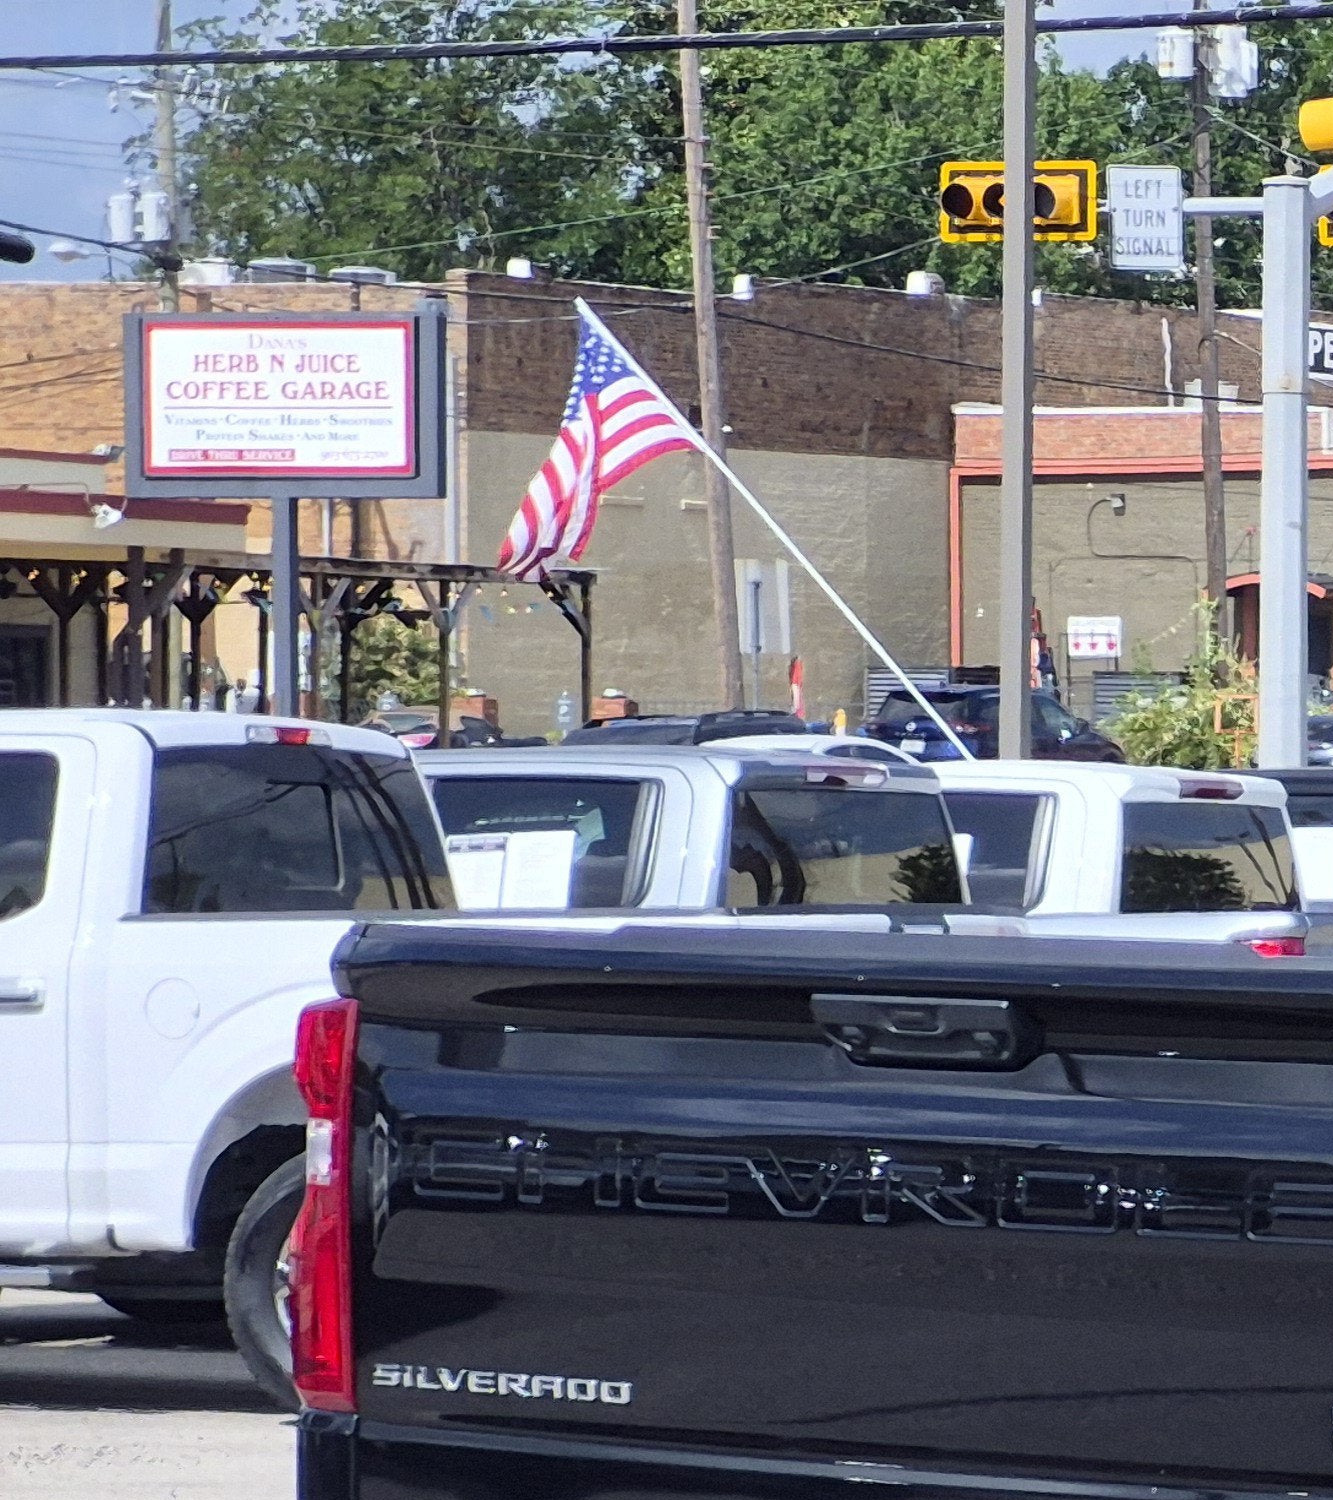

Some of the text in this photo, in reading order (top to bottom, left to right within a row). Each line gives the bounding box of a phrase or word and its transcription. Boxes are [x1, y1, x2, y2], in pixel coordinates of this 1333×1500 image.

[1124, 179, 1163, 199] LEFT
[1123, 208, 1166, 228] TURN
[1116, 236, 1176, 256] SIGNAL
[193, 354, 361, 373] HERB N JUICE
[165, 381, 391, 400] COFFEE GARAGE
[372, 1362, 633, 1405] SILVERADO
